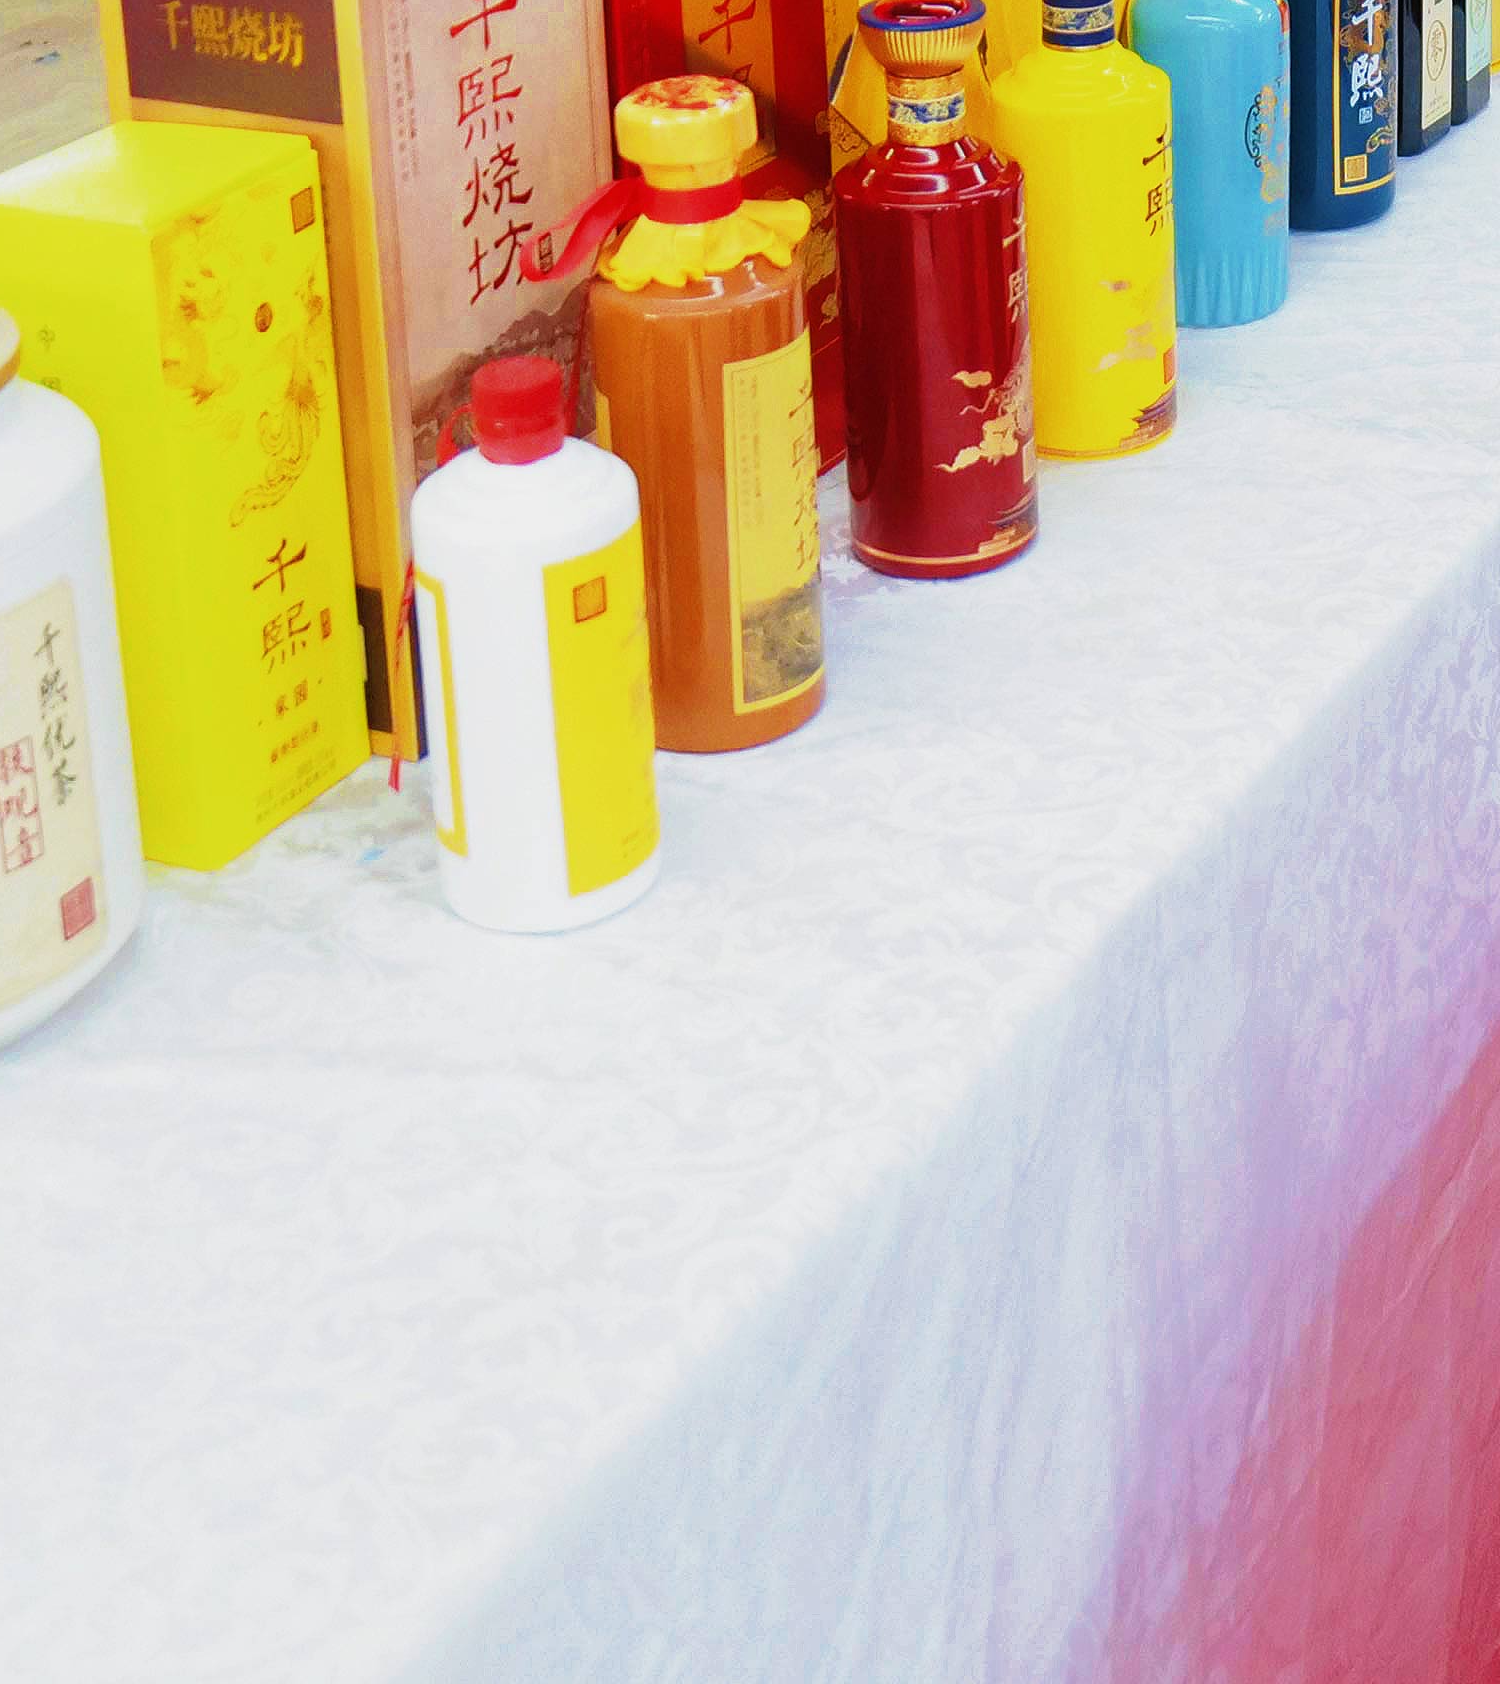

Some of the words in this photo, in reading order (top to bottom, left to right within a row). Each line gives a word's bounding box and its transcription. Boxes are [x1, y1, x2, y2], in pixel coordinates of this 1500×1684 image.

[156, 0, 306, 69] 千熙烧坊
[252, 537, 312, 675] 千熙
